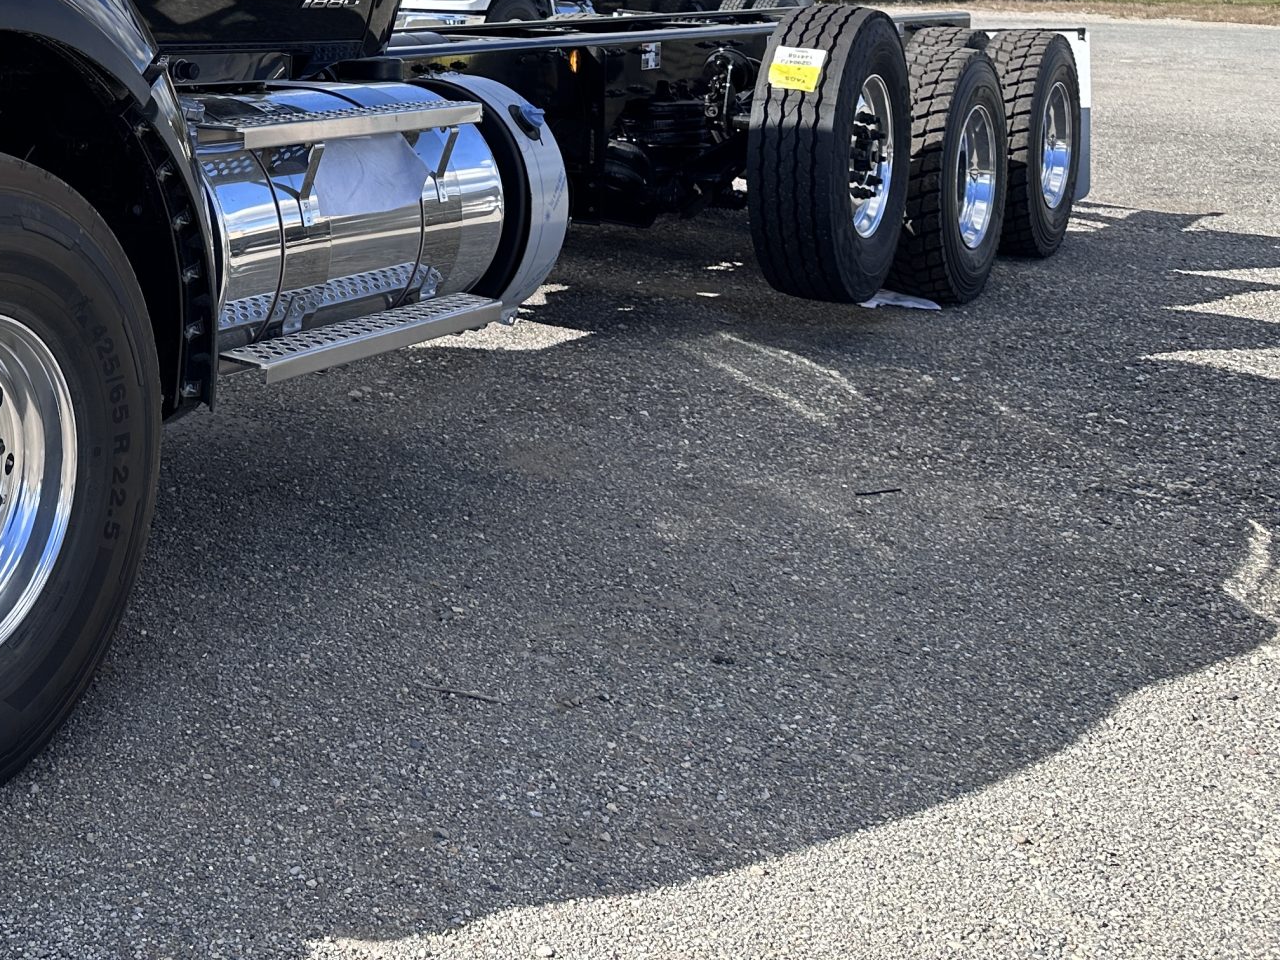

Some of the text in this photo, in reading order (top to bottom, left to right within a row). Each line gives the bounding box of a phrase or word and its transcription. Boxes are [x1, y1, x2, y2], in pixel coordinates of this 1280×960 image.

[93, 325, 131, 540] 425/65 R 22.5
